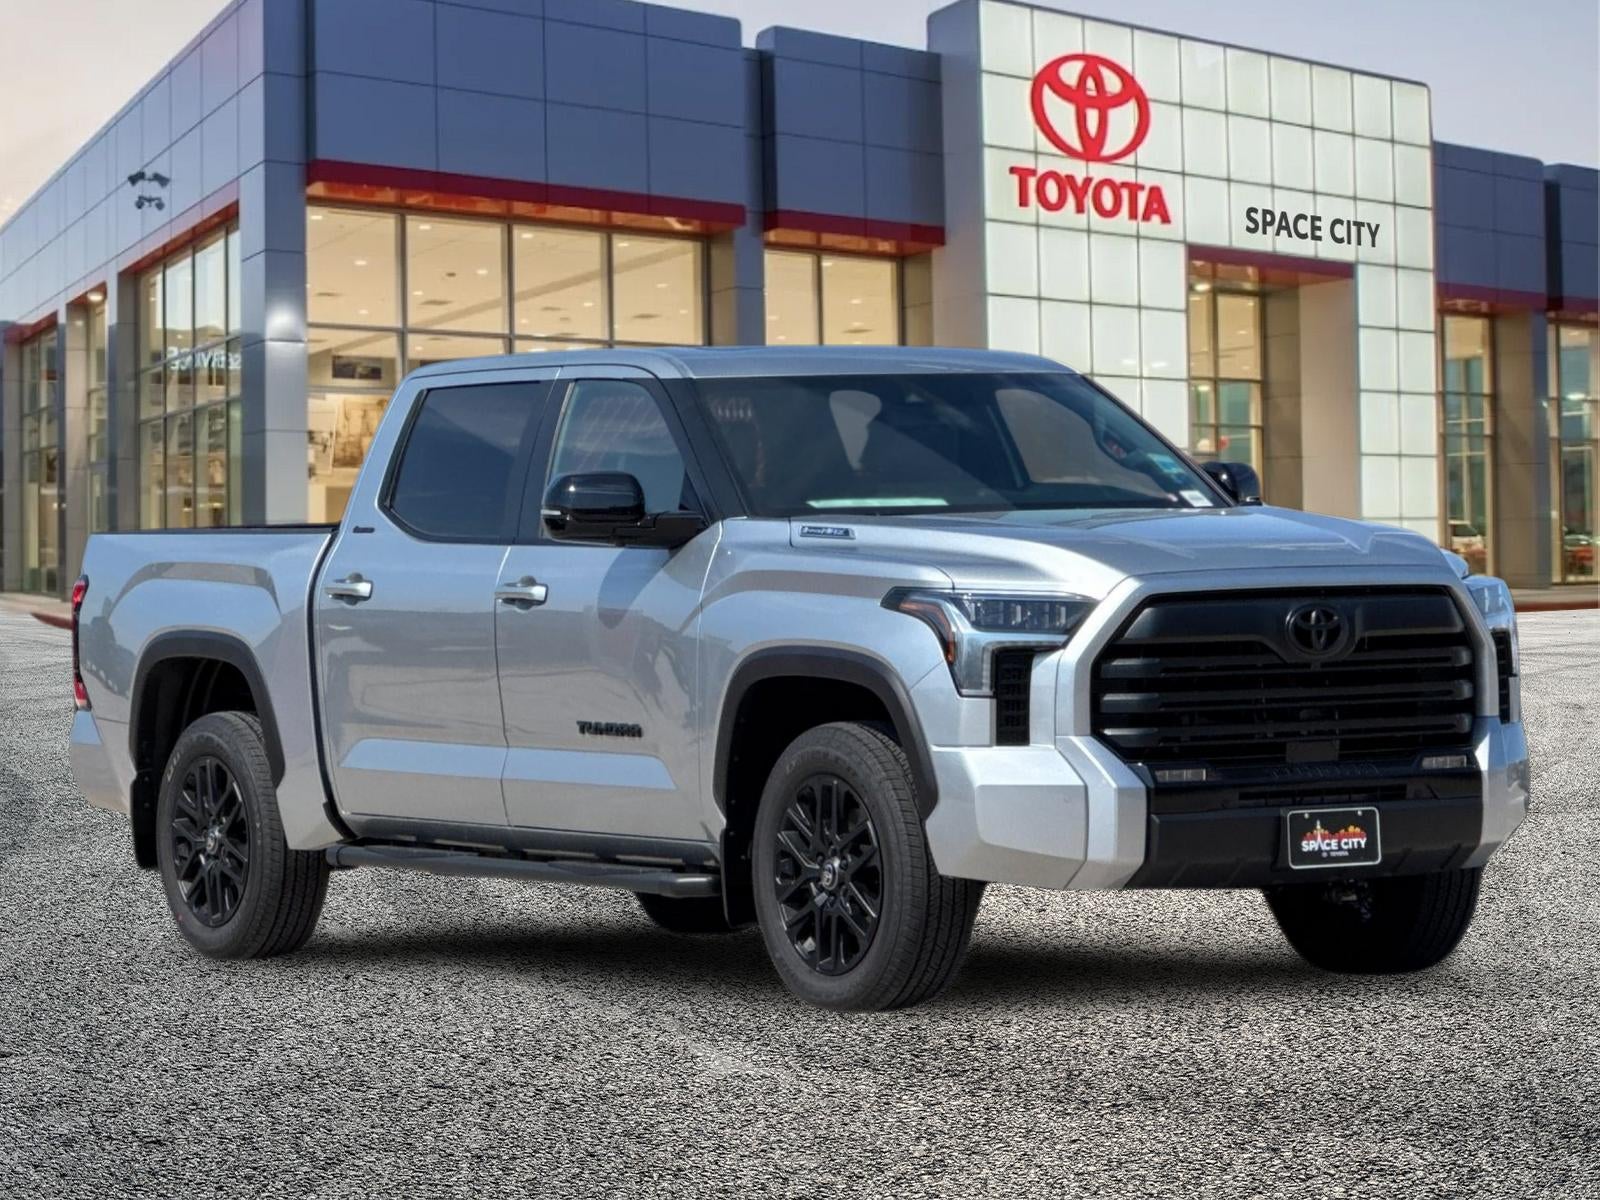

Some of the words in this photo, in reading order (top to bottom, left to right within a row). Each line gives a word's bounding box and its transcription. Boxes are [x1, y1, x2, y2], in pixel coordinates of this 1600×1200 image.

[1009, 166, 1172, 225] TOYOTA
[1245, 206, 1323, 242] SPACE
[1329, 217, 1381, 248] CITY
[1301, 839, 1339, 852] SPACE
[1340, 837, 1367, 849] CITY
